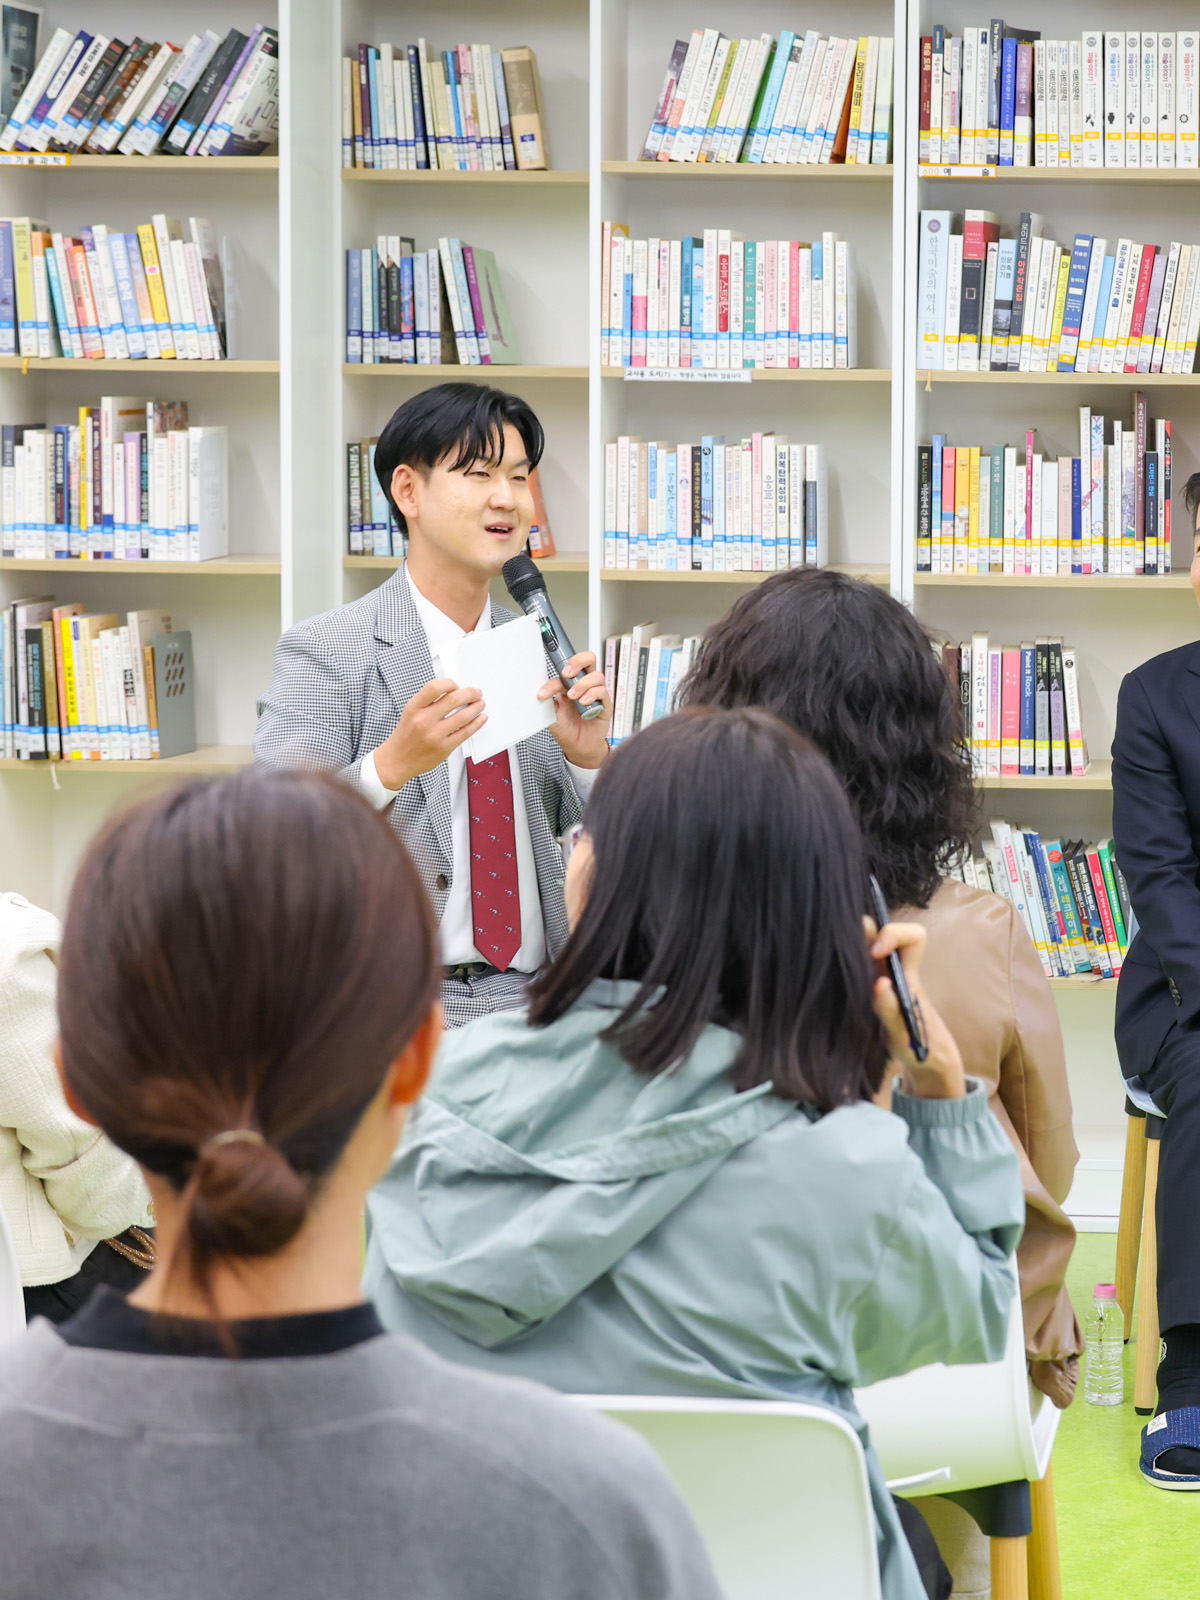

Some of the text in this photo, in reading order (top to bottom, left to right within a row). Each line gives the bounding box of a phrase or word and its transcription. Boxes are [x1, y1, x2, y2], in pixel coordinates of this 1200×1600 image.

[1000, 256, 1013, 265] 인문
[719, 279, 729, 315] 스트레스
[627, 369, 645, 378] 교사용
[648, 370, 671, 378] 도서(T)
[778, 451, 787, 503] 회복탄력성의
[1025, 650, 1033, 668] Paint
[32, 661, 41, 691] SCIENCE
[1024, 675, 1033, 698] Rock
